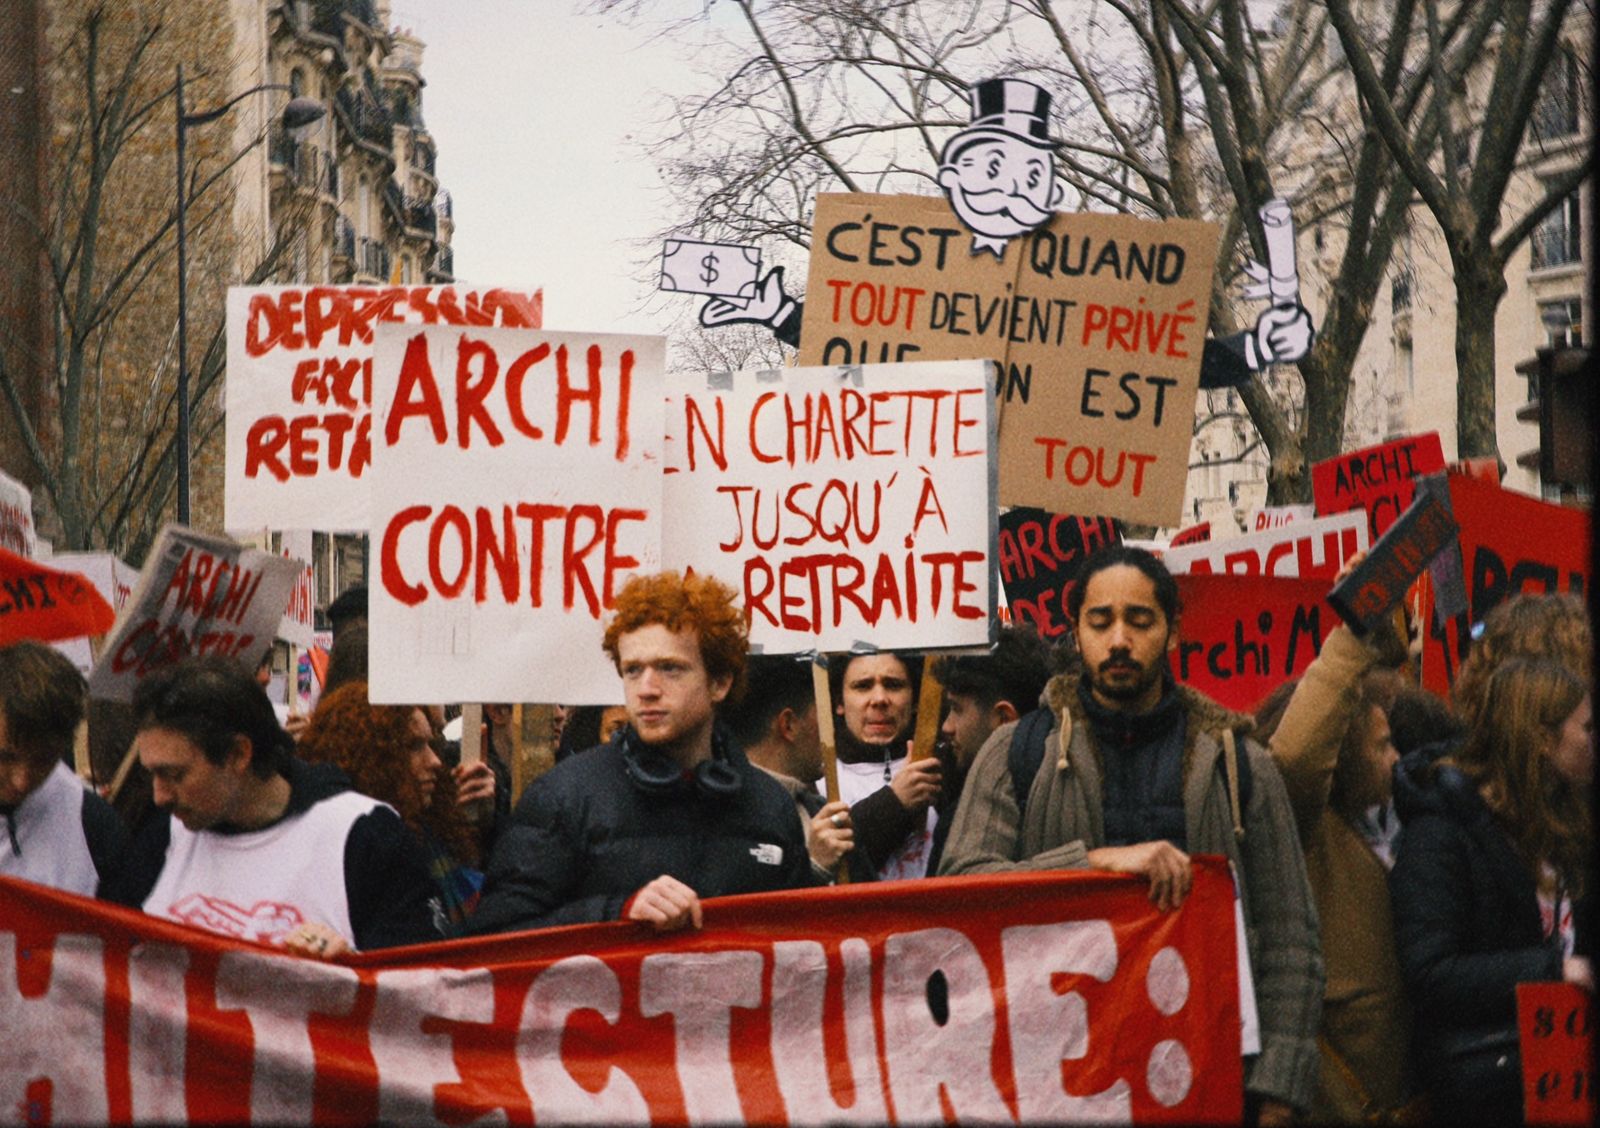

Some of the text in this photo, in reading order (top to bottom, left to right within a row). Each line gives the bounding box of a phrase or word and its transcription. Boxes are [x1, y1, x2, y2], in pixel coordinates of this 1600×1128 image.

[826, 214, 1187, 286] C'EST QUAND
[827, 280, 926, 331] TOUT
[384, 331, 634, 463] ARCHI
[749, 387, 986, 469] CHARETTE
[1079, 368, 1178, 428] EST
[1034, 437, 1158, 498] TOUT
[1335, 445, 1421, 497] ARCHI
[380, 503, 648, 619] CONTRE
[998, 513, 1115, 584] ARCHI
[157, 547, 264, 626] ARCHI
